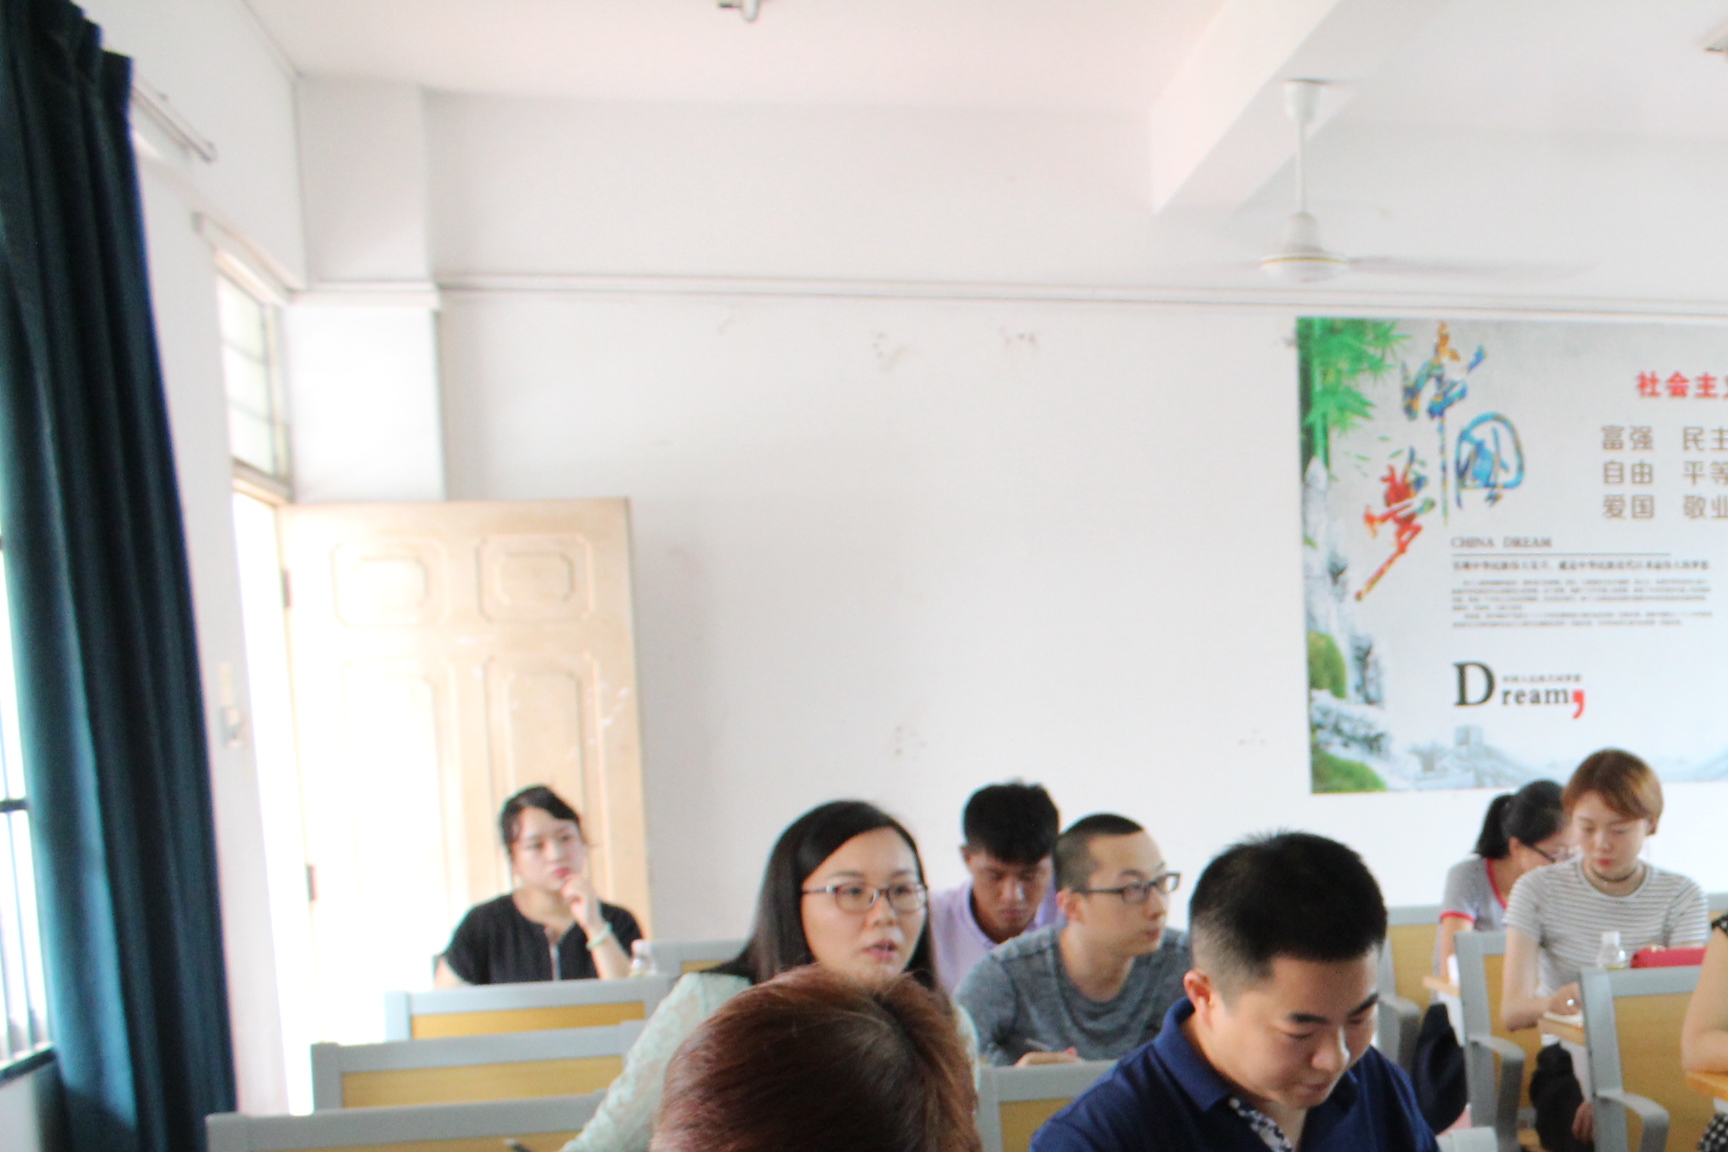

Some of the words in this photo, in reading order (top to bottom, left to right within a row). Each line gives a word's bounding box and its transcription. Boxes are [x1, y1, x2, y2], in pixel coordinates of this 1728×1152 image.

[1601, 425, 1653, 452] 富强
[1602, 460, 1654, 486] 自由
[1602, 494, 1655, 520] 爱国
